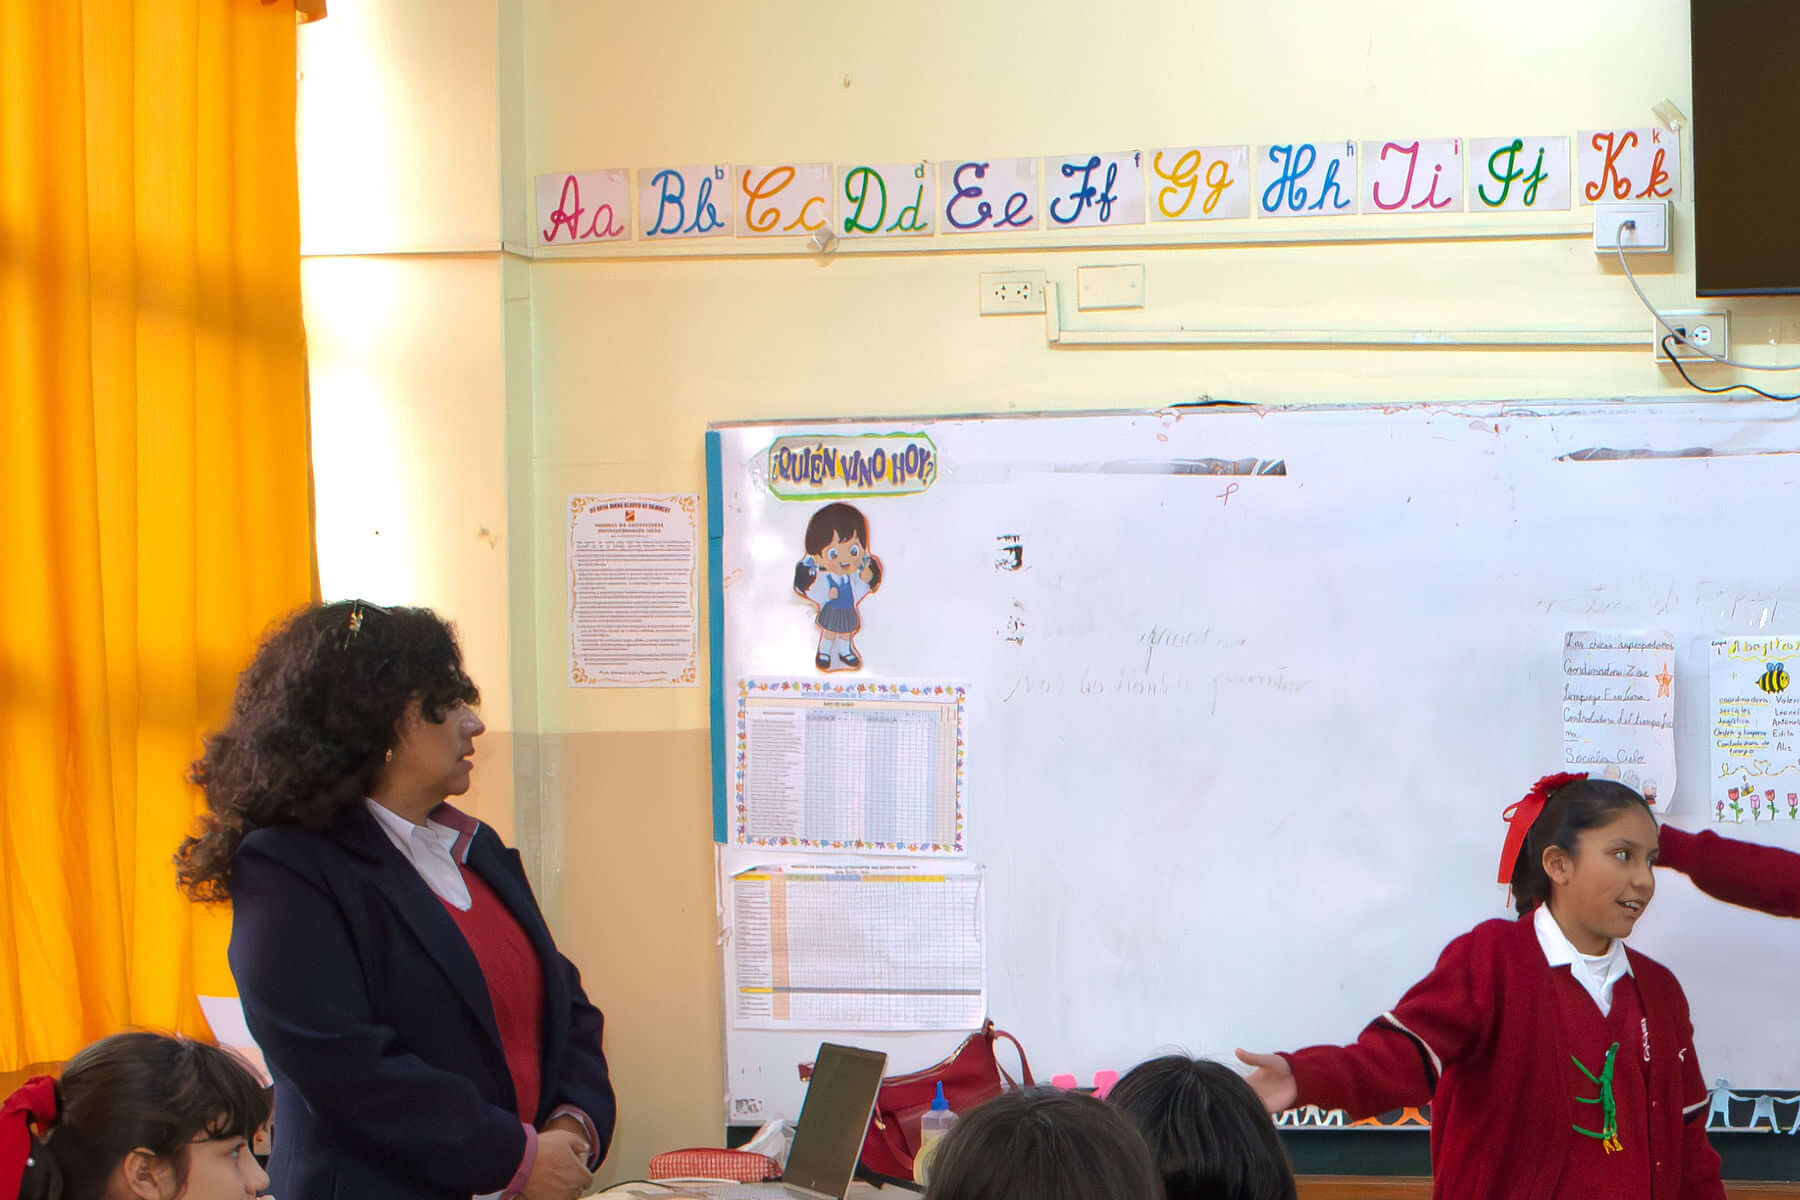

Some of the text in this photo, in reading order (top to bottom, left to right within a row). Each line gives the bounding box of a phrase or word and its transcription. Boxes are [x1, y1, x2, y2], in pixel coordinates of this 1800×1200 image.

[742, 166, 826, 233] Cc
[945, 162, 1034, 230] Ee
[1050, 155, 1118, 223] Ff
[1153, 150, 1234, 218] Gg
[1262, 143, 1350, 212] Hh
[1585, 131, 1673, 200] Kk
[543, 173, 625, 242] Aa
[646, 169, 725, 236] Bb
[838, 166, 928, 234] Dd
[840, 449, 886, 487] VINO
[892, 443, 934, 485] HOY?
